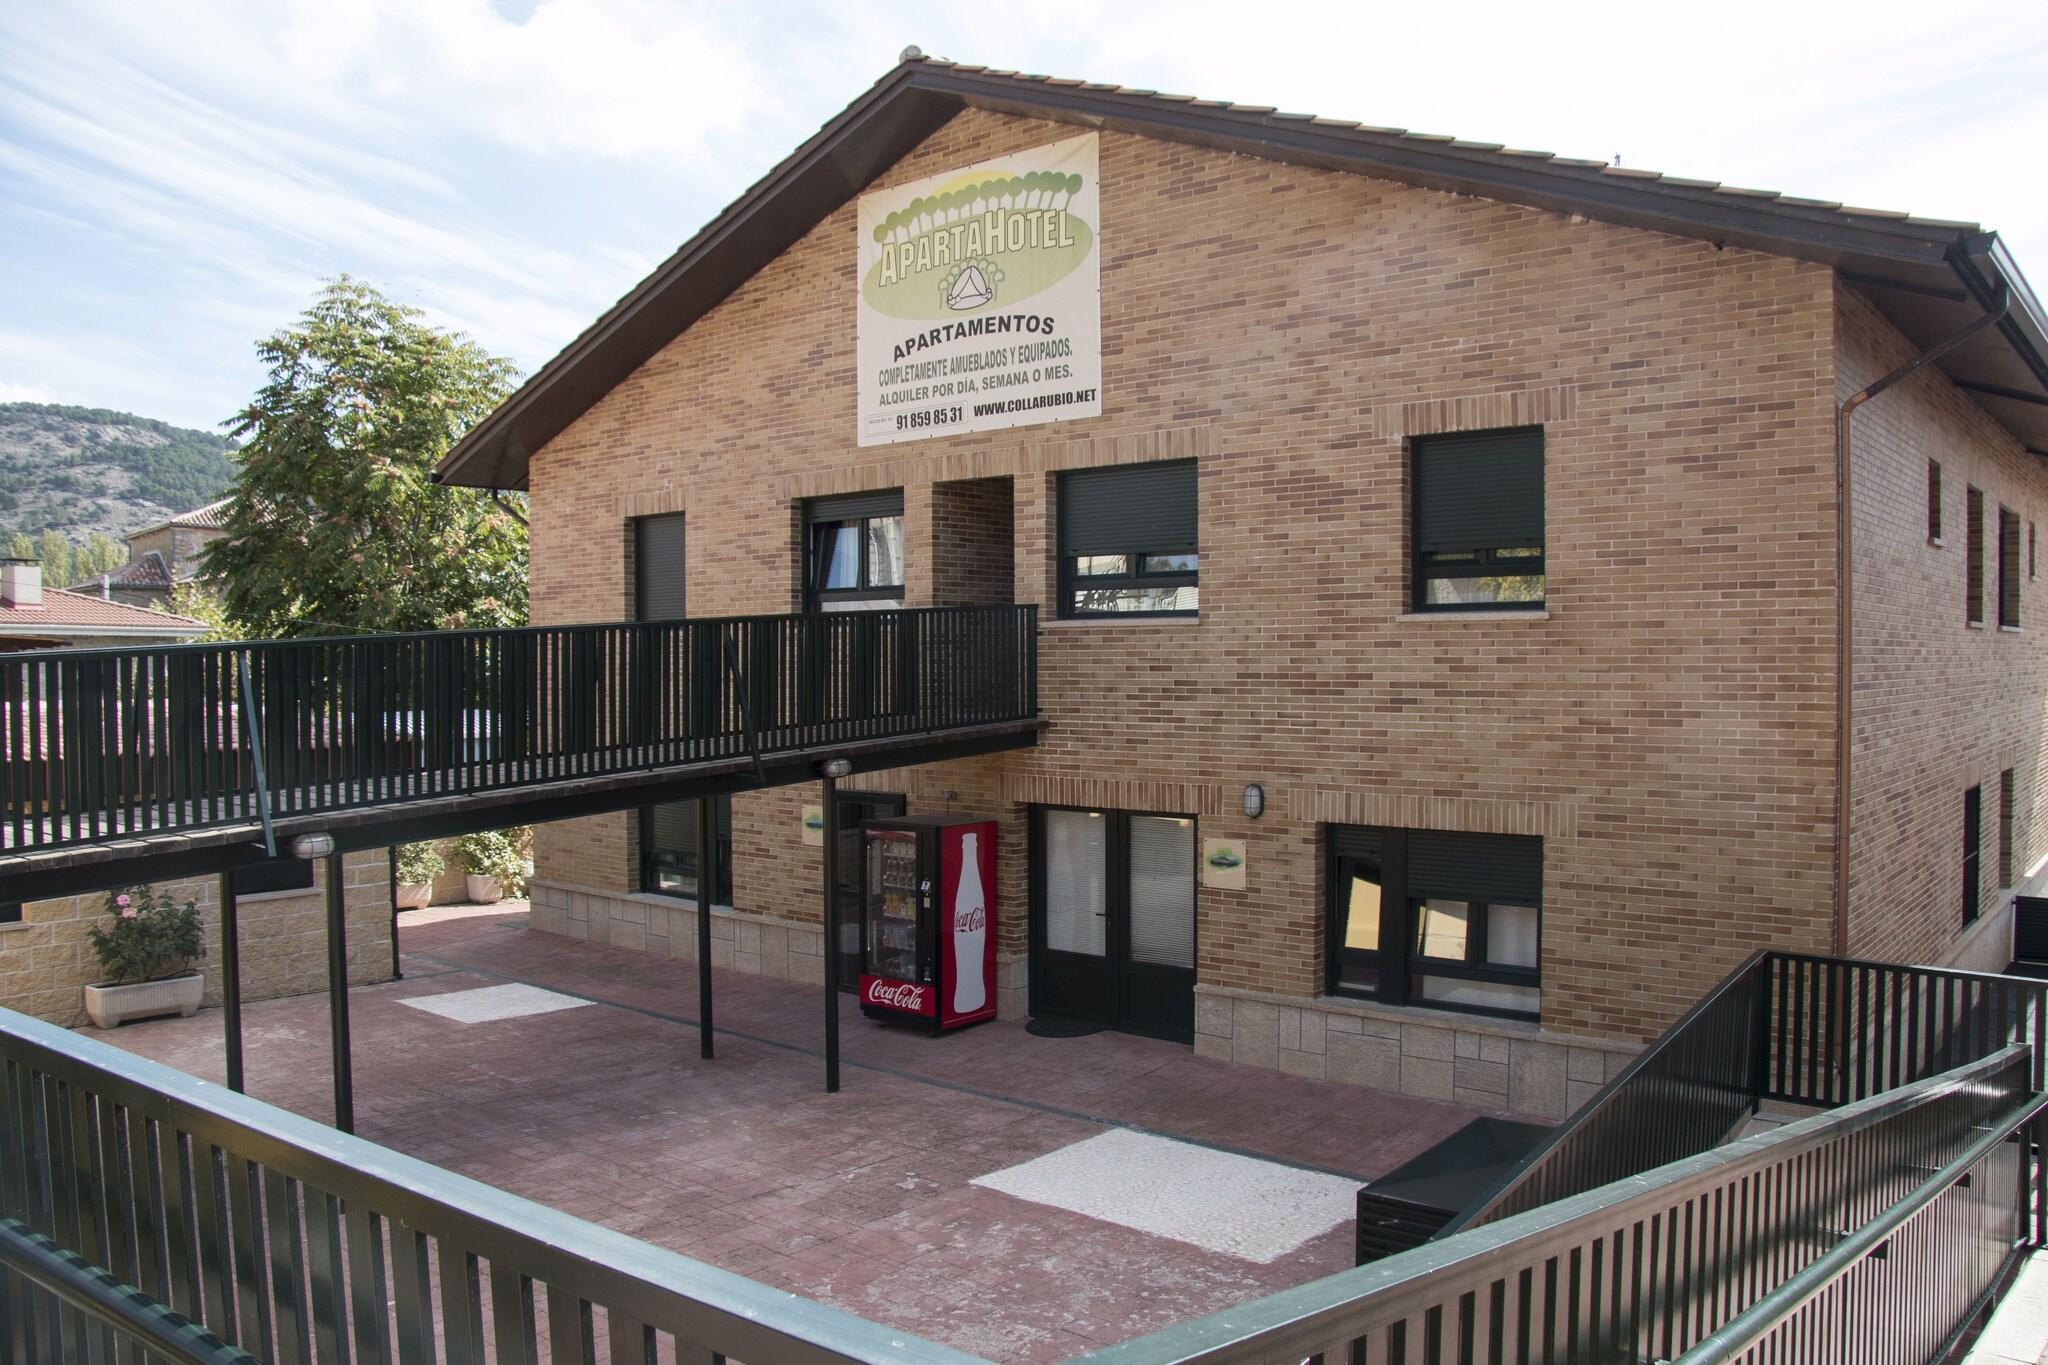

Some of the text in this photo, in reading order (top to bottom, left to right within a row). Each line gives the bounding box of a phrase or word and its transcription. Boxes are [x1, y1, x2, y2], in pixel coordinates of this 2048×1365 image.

[893, 314, 1055, 362] APARTAMENTOS
[879, 338, 1072, 387] COMPLETAMENTE AMUEBLADOS Y EQUIPADOS.
[879, 364, 1072, 407] ALQUILER POR DÍA, SEMANA O MES.
[896, 415, 908, 429] 91
[910, 411, 931, 428] 859
[933, 408, 948, 424] 85
[950, 406, 963, 422] 31
[974, 388, 1097, 417] WWW.COLLARUBIO.NET
[869, 979, 925, 1010] Coca-Cola
